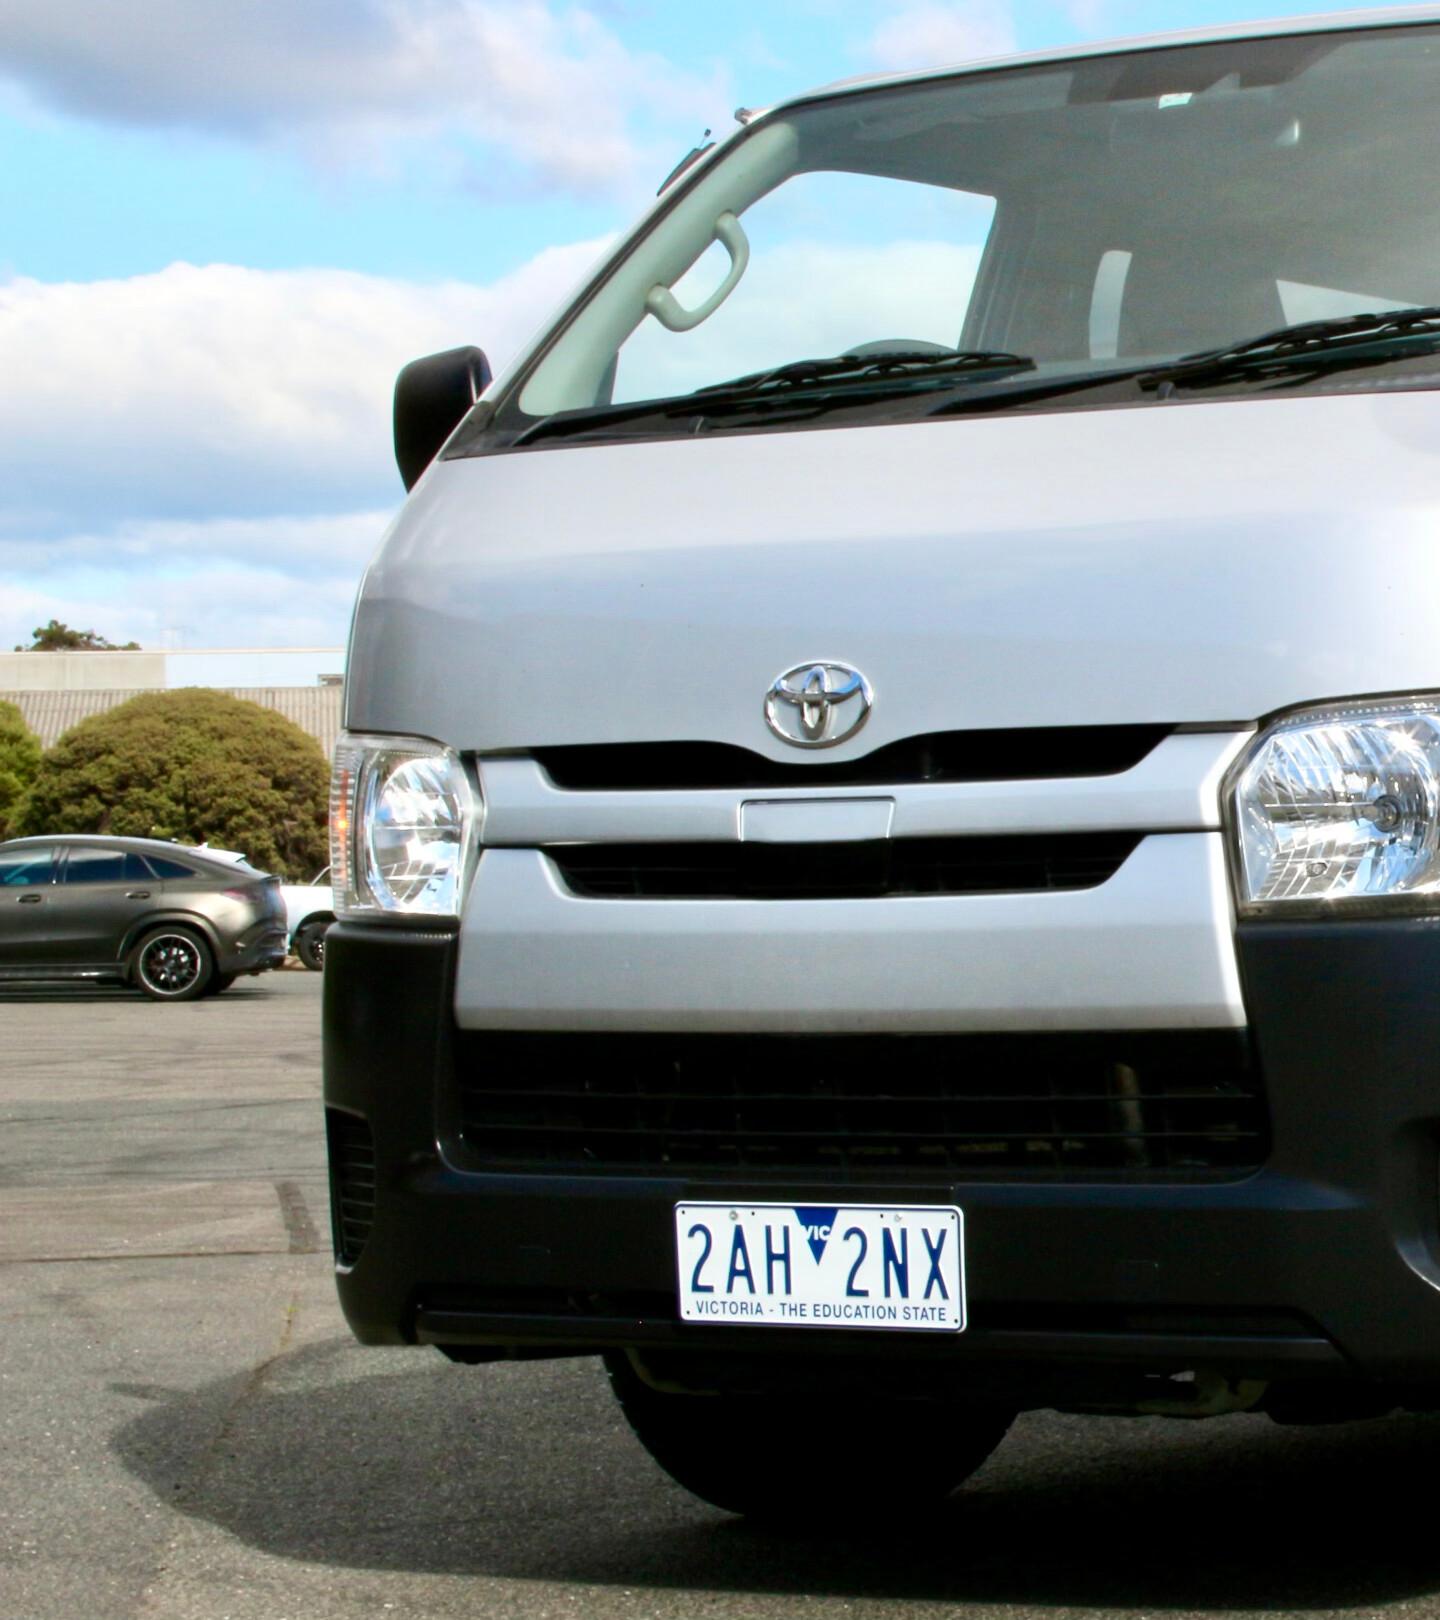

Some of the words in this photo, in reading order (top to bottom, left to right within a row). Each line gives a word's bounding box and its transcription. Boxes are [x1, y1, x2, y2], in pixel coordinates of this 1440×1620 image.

[801, 1225, 831, 1240] VIC
[687, 1223, 792, 1295] 2AH
[842, 1226, 950, 1300] 2NX
[696, 1300, 763, 1315] VICTORIA
[780, 1302, 807, 1317] THE
[813, 1303, 897, 1319] EDUCATION
[903, 1306, 946, 1321] STATE
